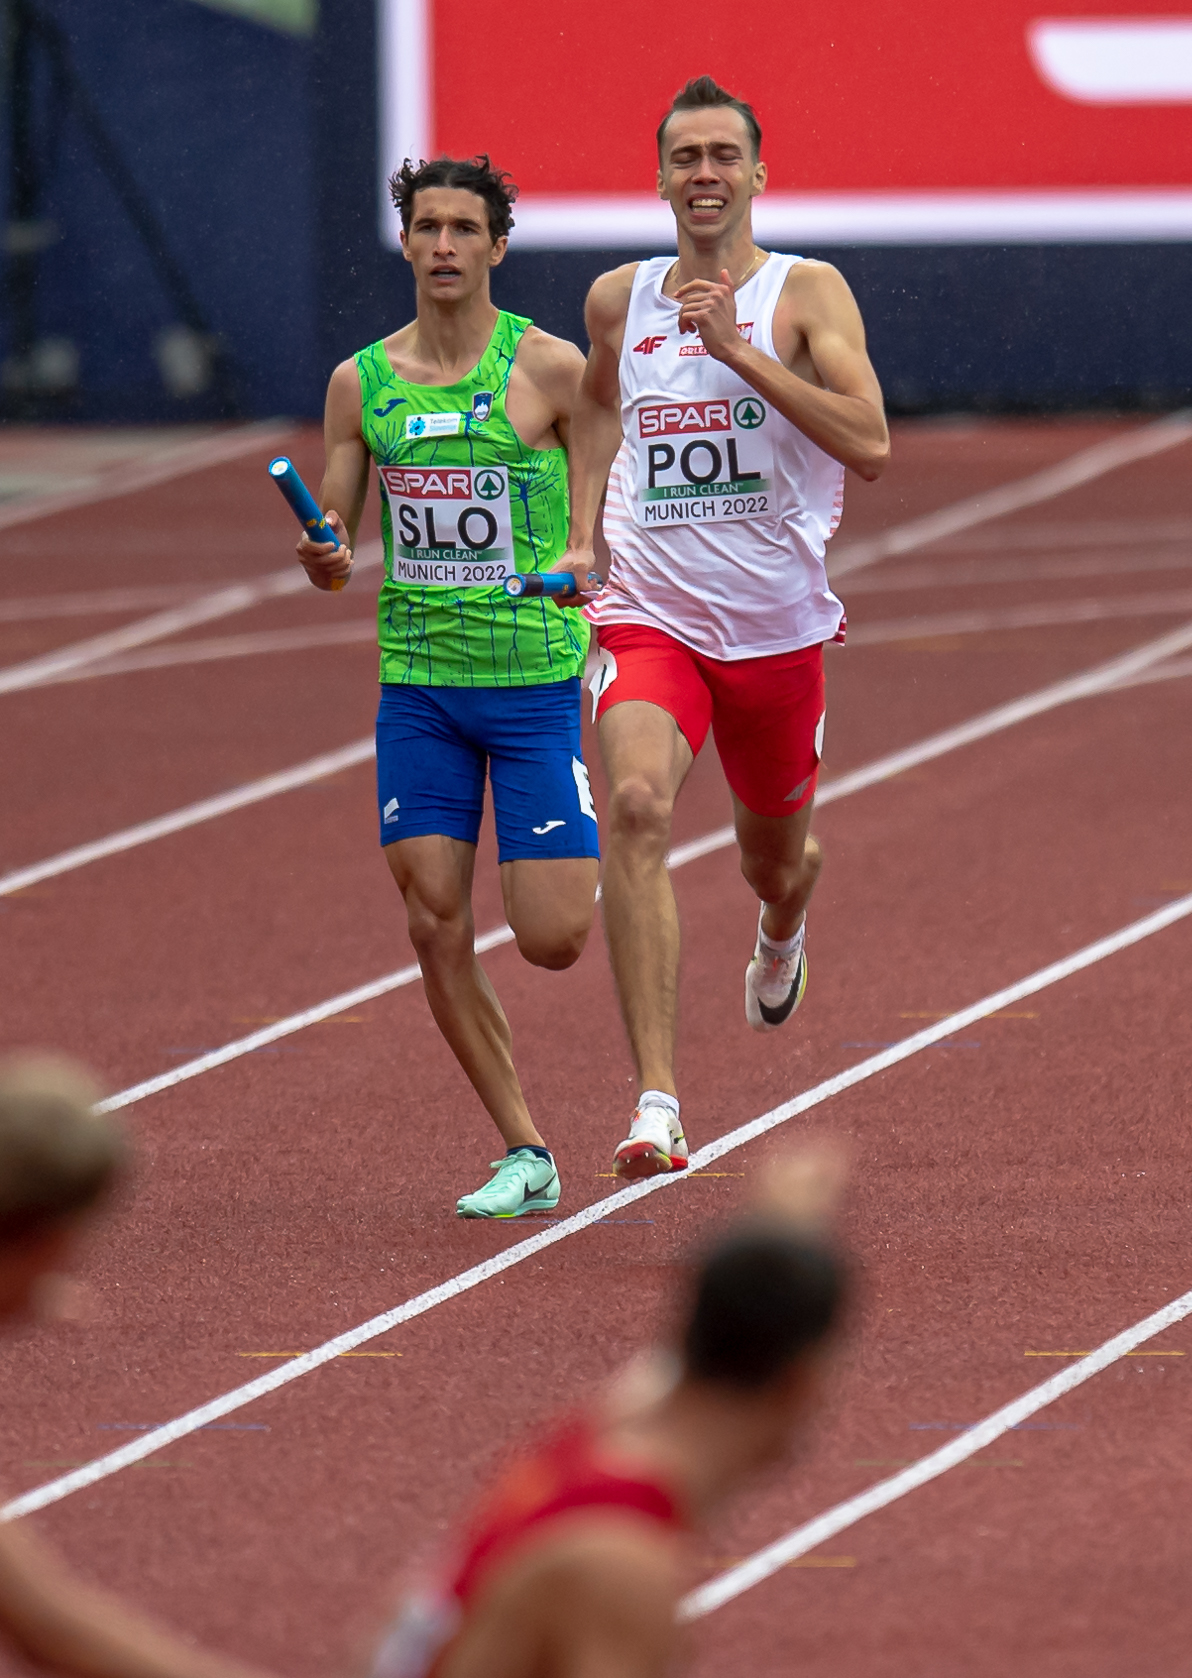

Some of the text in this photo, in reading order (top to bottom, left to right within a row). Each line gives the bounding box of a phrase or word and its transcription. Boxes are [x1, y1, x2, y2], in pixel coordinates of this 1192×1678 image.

[641, 404, 728, 434] SPAR
[648, 438, 761, 489] POL
[386, 471, 470, 495] SPAR
[670, 486, 696, 497] RUN
[645, 496, 768, 522] MUNICH 2022
[398, 503, 498, 551] SLO
[416, 549, 440, 559] RUN
[398, 561, 507, 582] MUNICH 2022
